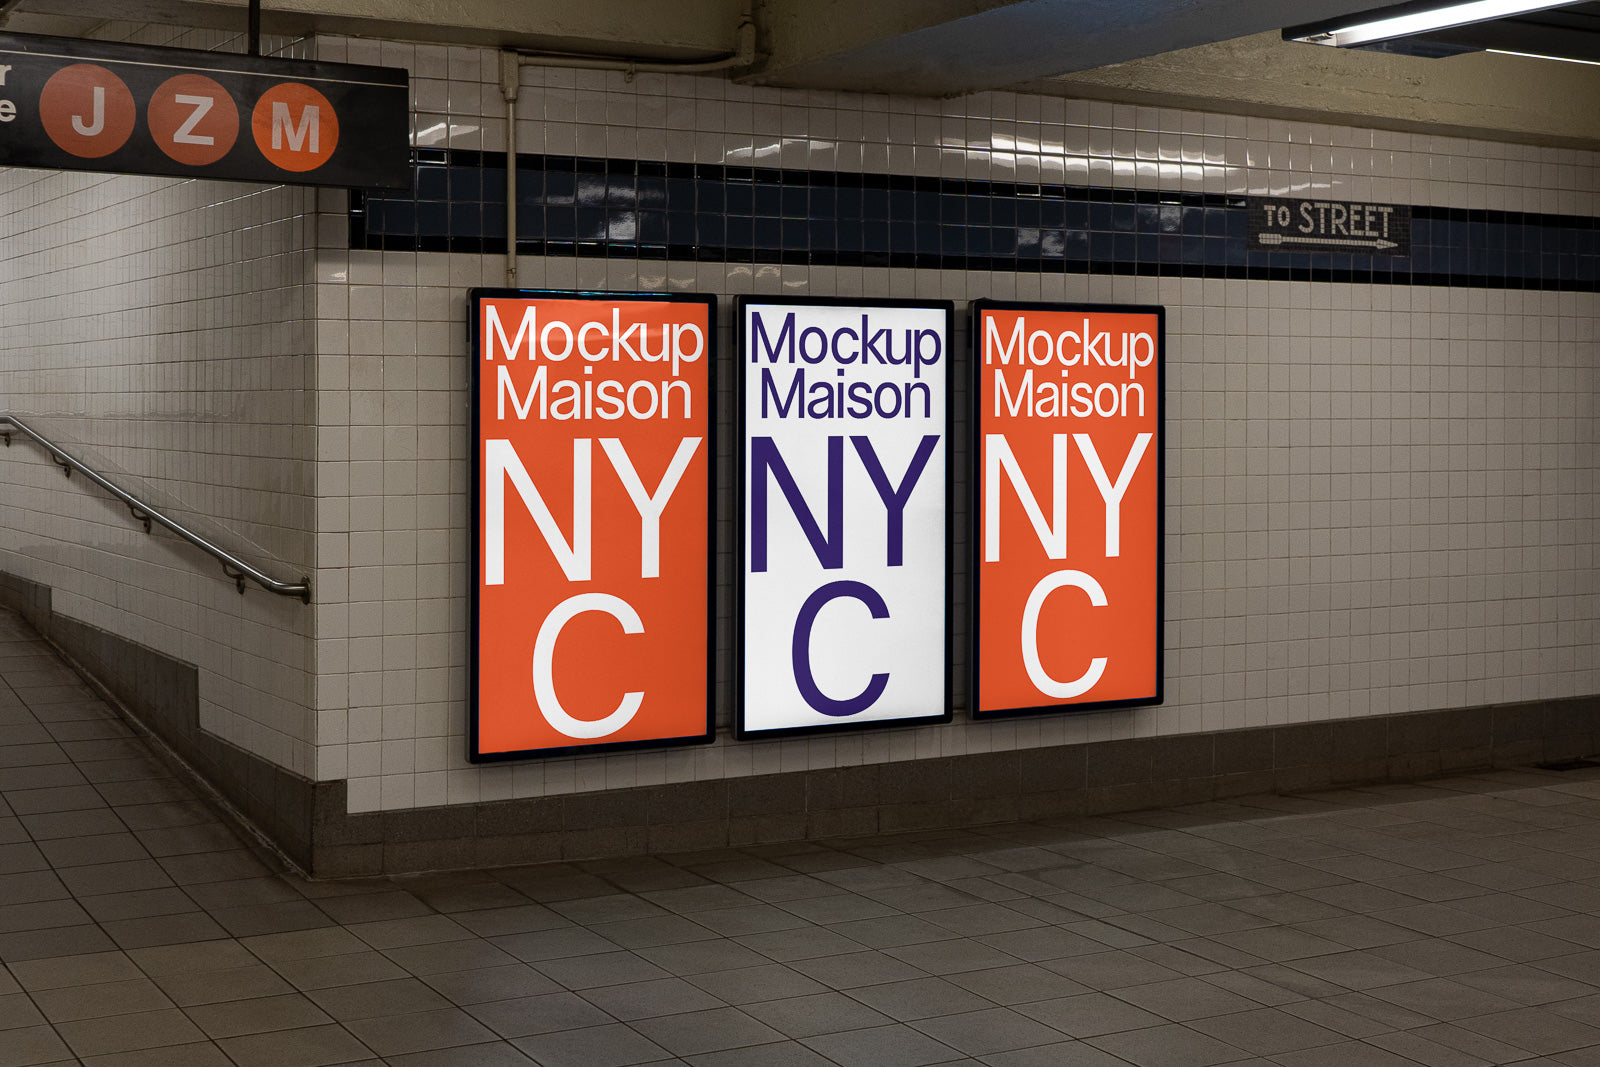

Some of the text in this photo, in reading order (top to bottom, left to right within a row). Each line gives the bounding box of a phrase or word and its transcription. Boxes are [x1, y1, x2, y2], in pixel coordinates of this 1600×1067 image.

[71, 86, 320, 154] J Z M
[1263, 201, 1394, 238] TO STREET
[485, 304, 704, 377] Mockup
[751, 311, 942, 379] Mockup
[985, 315, 1155, 380] Mockup
[497, 364, 692, 421] Maison
[761, 367, 931, 420] Maison
[994, 368, 1145, 418] Maison
[485, 436, 703, 586] NY
[750, 434, 941, 573] NY
[984, 432, 1154, 563] NY
[532, 592, 645, 740] C
[791, 579, 891, 718] C
[1021, 569, 1109, 699] C
